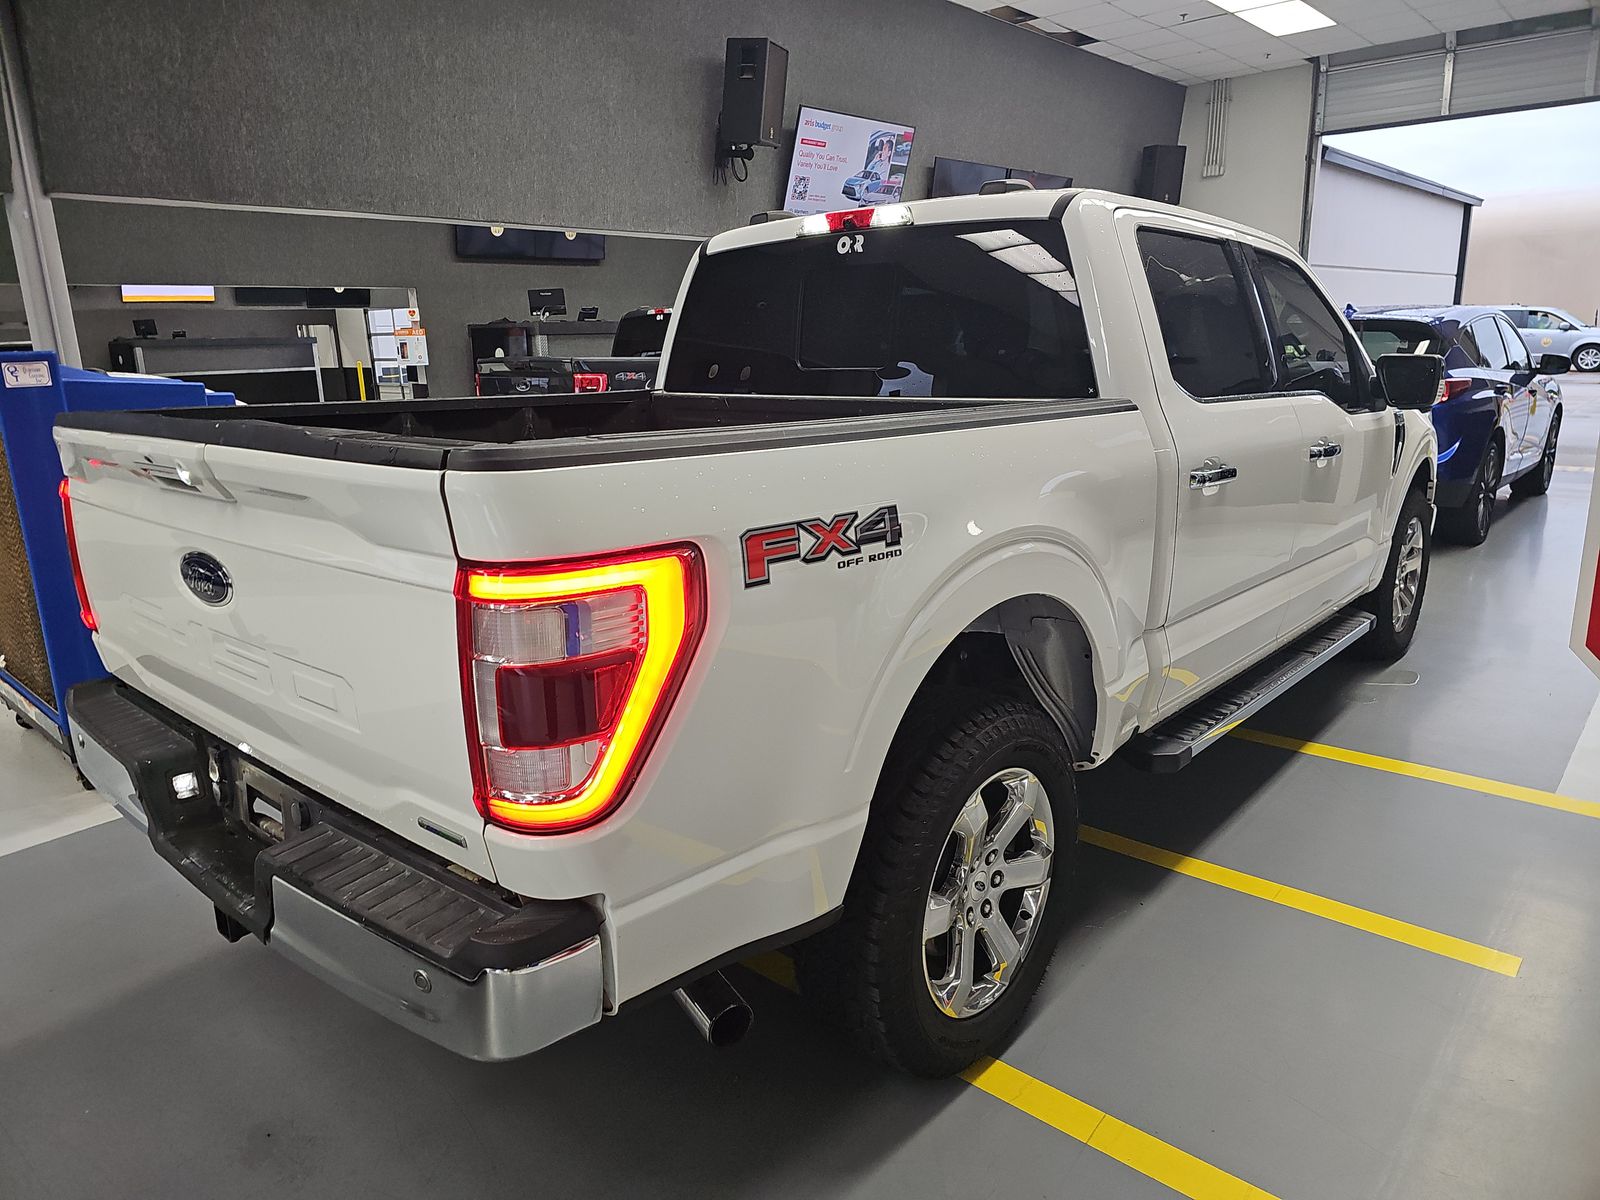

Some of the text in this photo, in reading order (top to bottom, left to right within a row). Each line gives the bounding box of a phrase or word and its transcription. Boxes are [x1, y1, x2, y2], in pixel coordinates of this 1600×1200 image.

[815, 119, 832, 130] budget
[799, 149, 816, 160] Quality
[816, 152, 826, 160] You
[797, 160, 814, 169] Variety
[826, 164, 839, 172] Love
[739, 503, 903, 589] FX4
[837, 548, 903, 569] OFF ROAD
